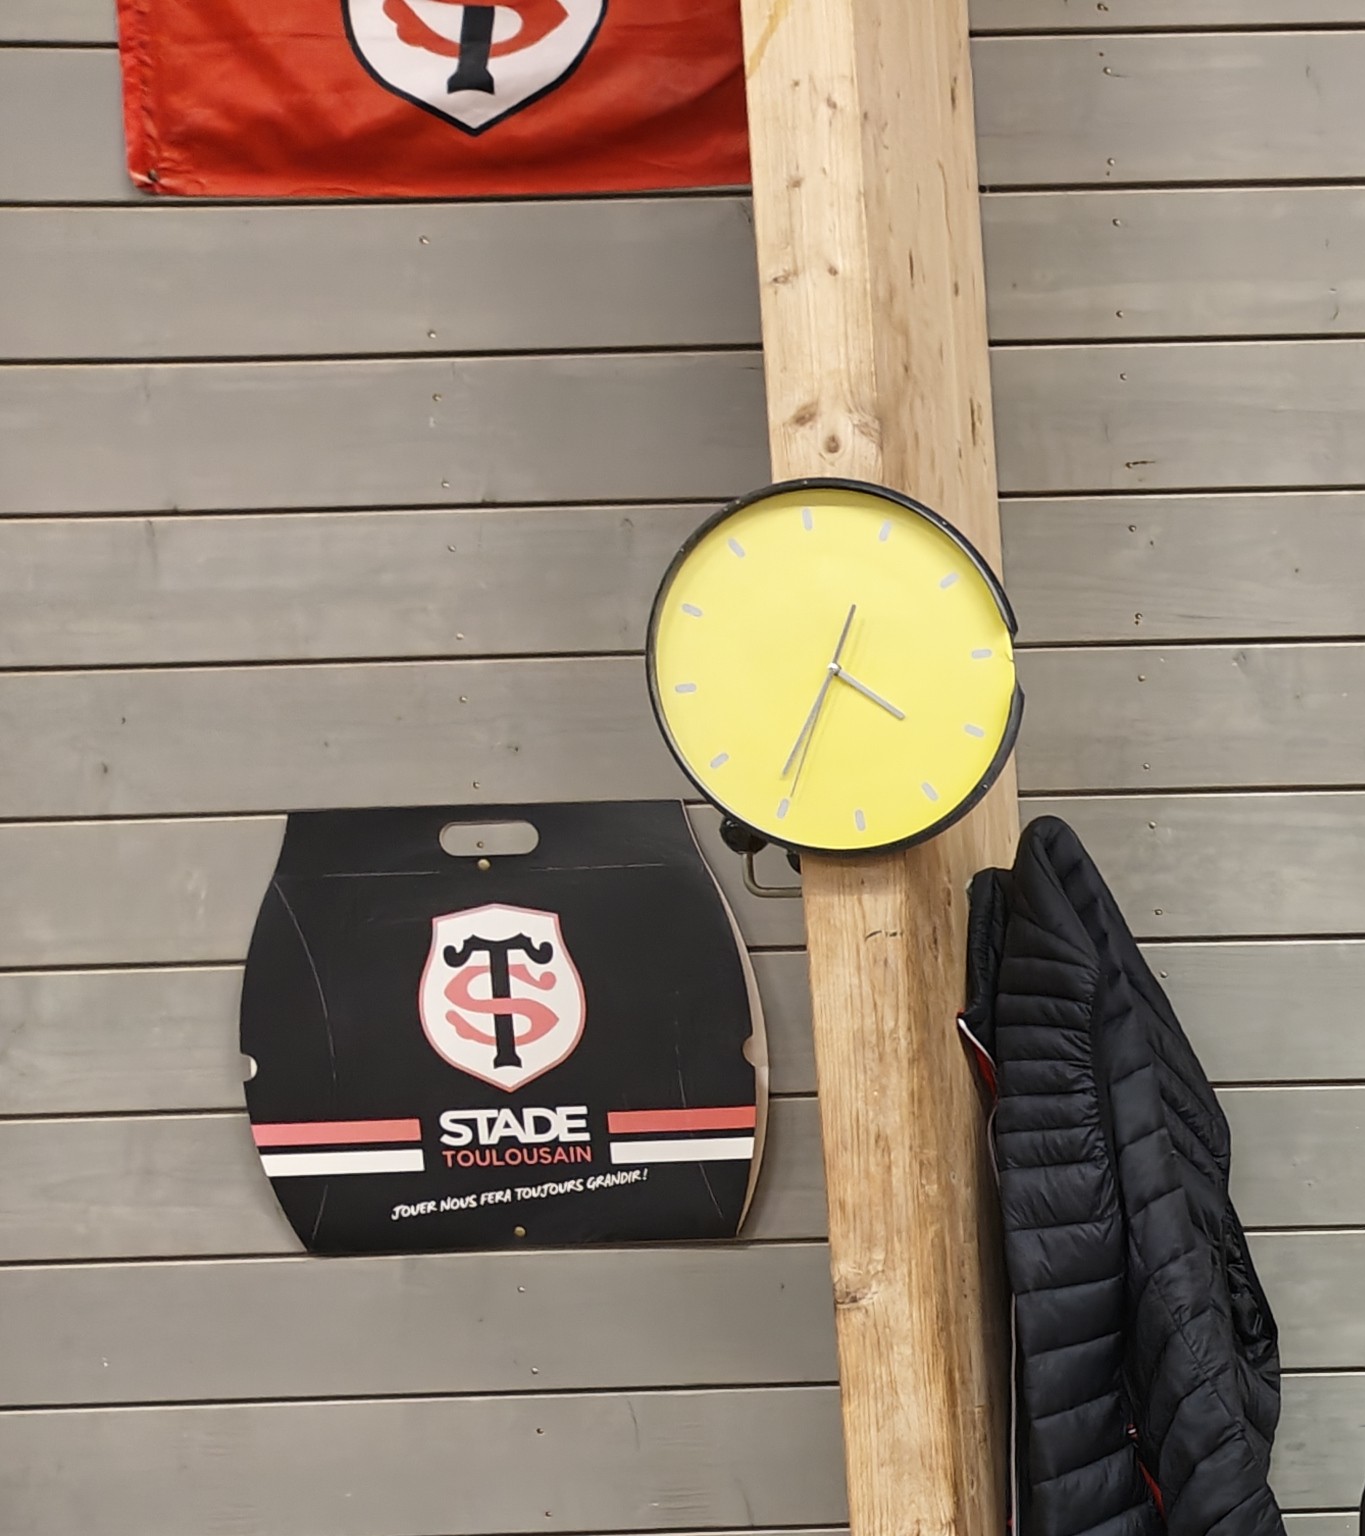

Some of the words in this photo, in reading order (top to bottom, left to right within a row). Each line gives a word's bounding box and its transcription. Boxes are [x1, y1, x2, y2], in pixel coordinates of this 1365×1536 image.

[439, 1105, 592, 1147] STADE
[442, 1146, 592, 1168] TOULOUSAIN
[391, 1200, 438, 1221] JOUER
[440, 1196, 477, 1213] NOUS
[480, 1189, 512, 1206] FERA
[514, 1178, 584, 1200] TOUJOURS
